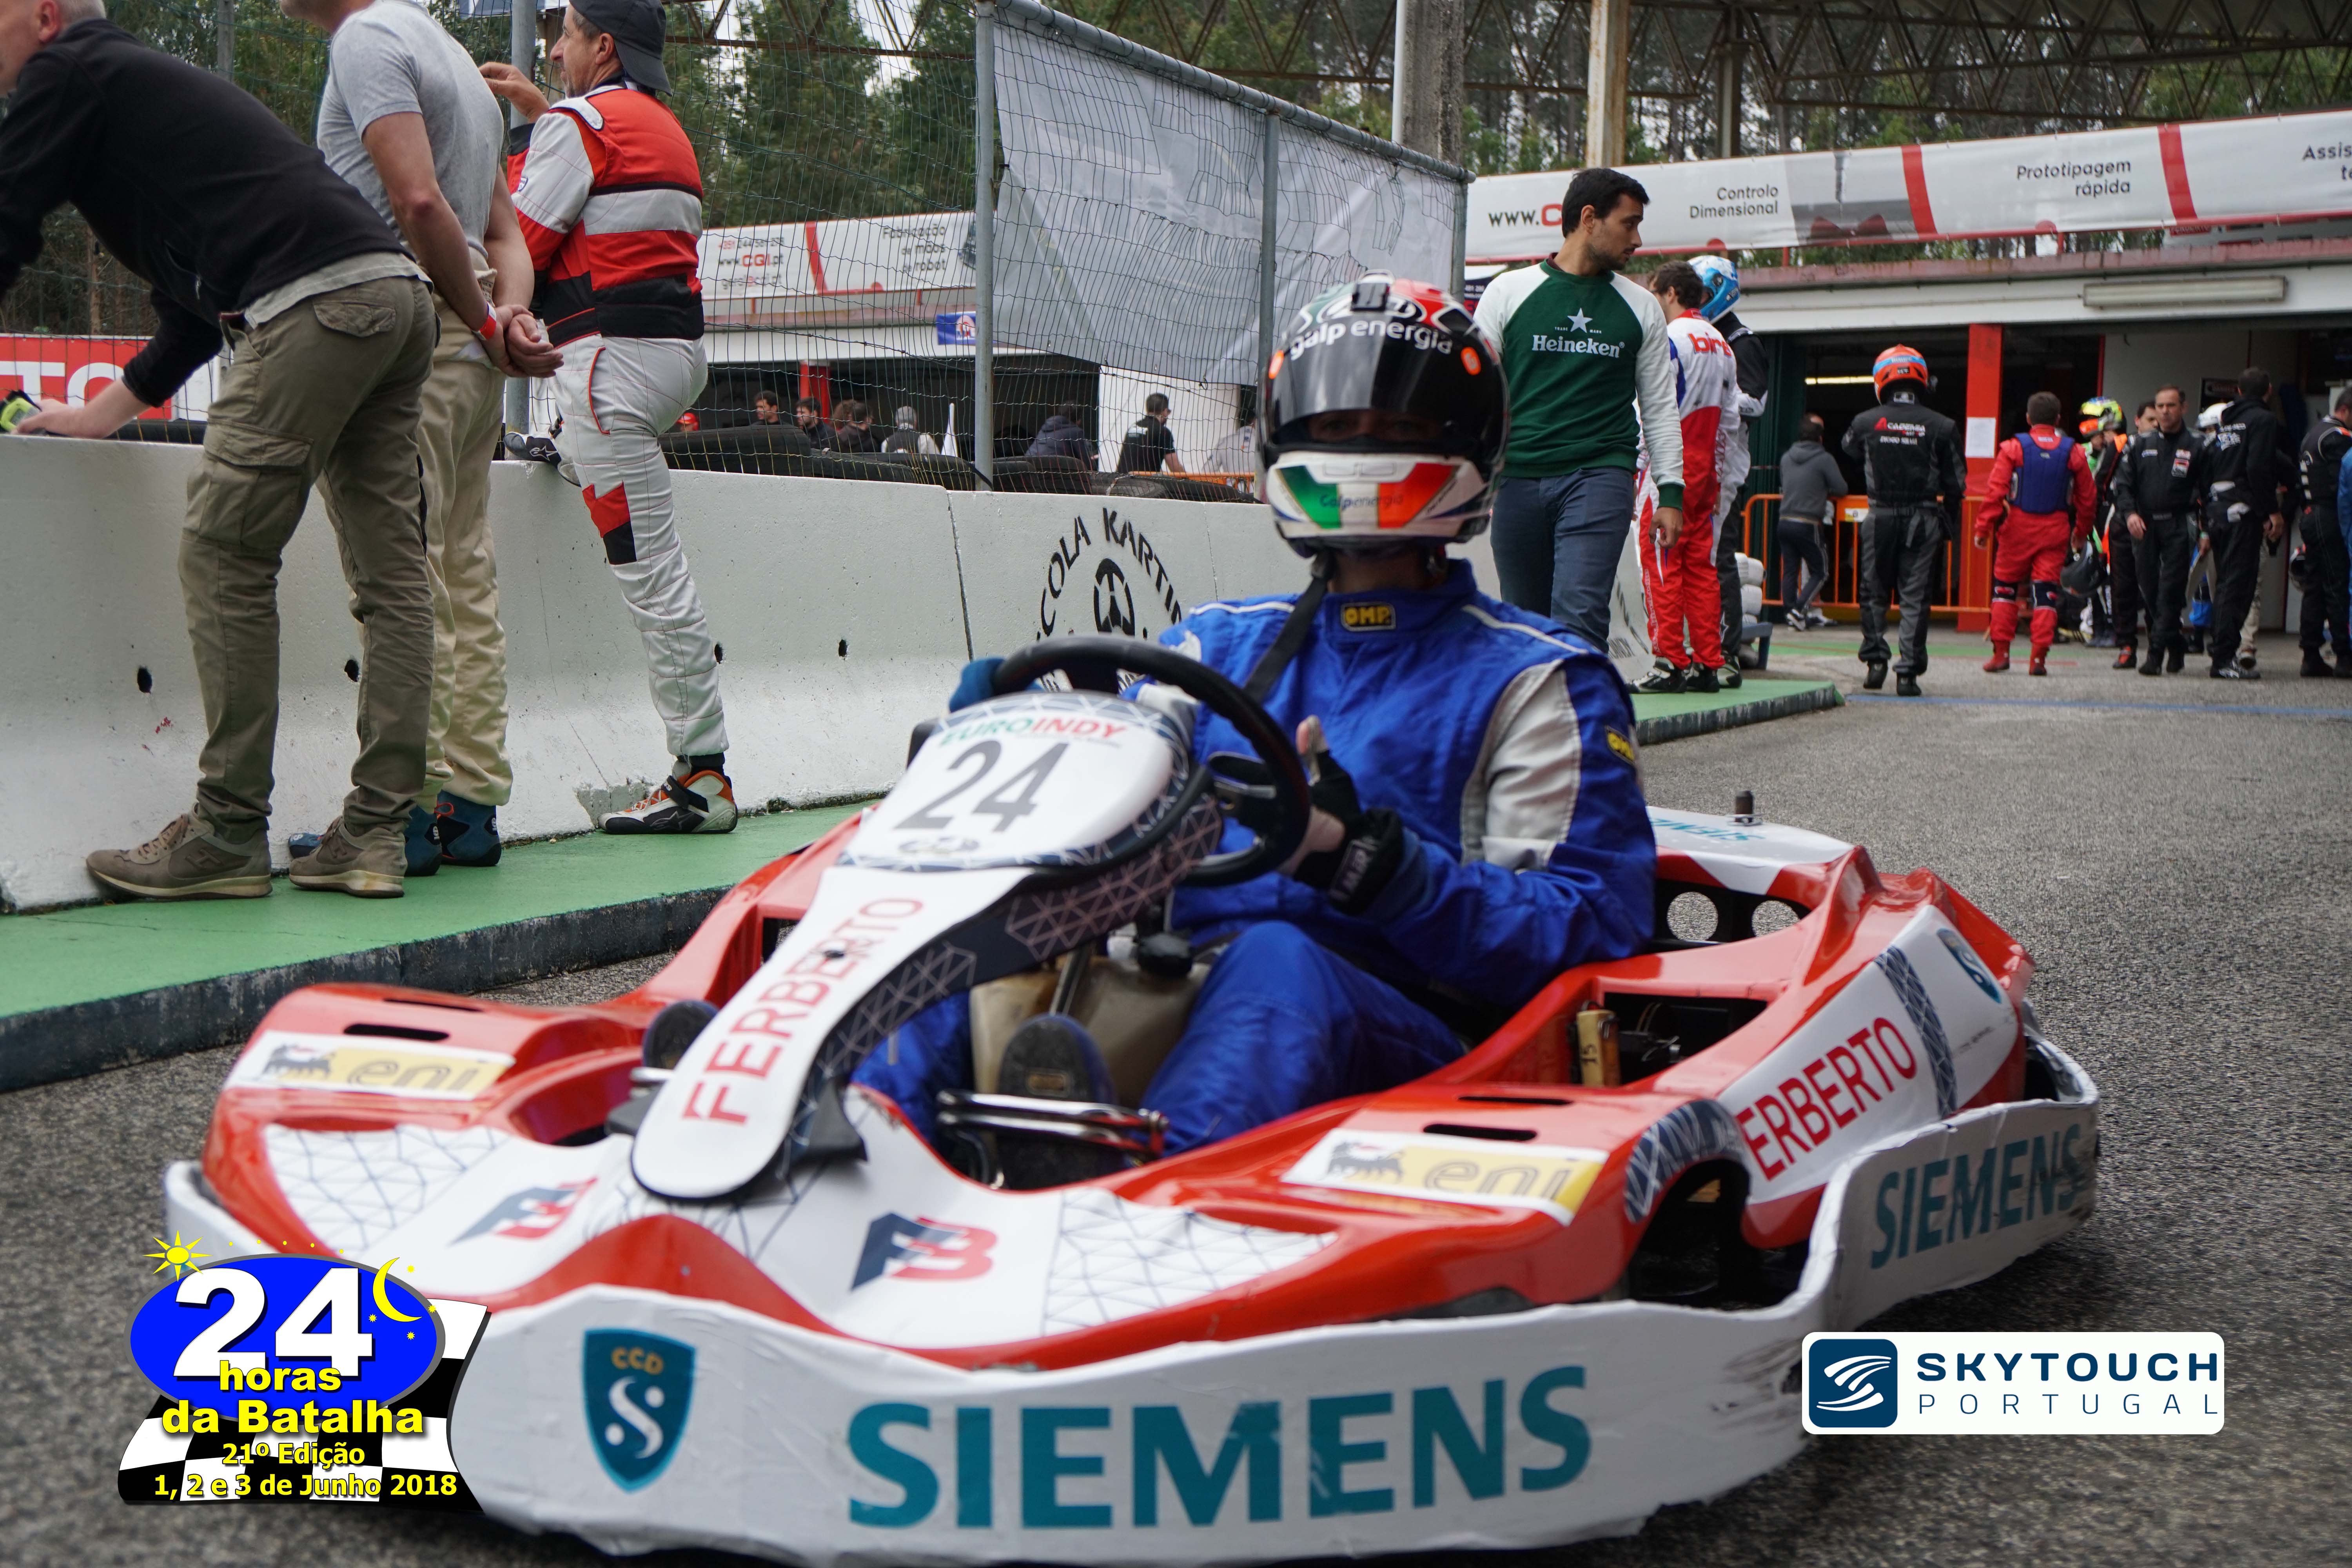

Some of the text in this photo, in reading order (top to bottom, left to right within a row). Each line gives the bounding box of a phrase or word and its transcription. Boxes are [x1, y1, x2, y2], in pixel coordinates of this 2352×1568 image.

[2301, 141, 2352, 161] Assis
[2016, 160, 2131, 180] Prototipagem
[1717, 183, 1778, 201] Controlo
[2075, 178, 2131, 198] rápida
[1689, 199, 1778, 219] Dimensional
[882, 223, 946, 239] Fabricação
[915, 241, 946, 254] mãos
[915, 258, 946, 271] robot
[1290, 320, 1452, 361] galp energia
[940, 717, 1128, 746] EUROINDY
[894, 739, 1070, 833] 24
[681, 898, 924, 1125] FERBERTO
[347, 1058, 488, 1090] eni
[1424, 1156, 1581, 1201] eni
[1870, 1123, 2082, 1269] SIEMENS
[611, 1346, 664, 1376] CCD
[847, 1365, 1590, 1529] SIEMENS
